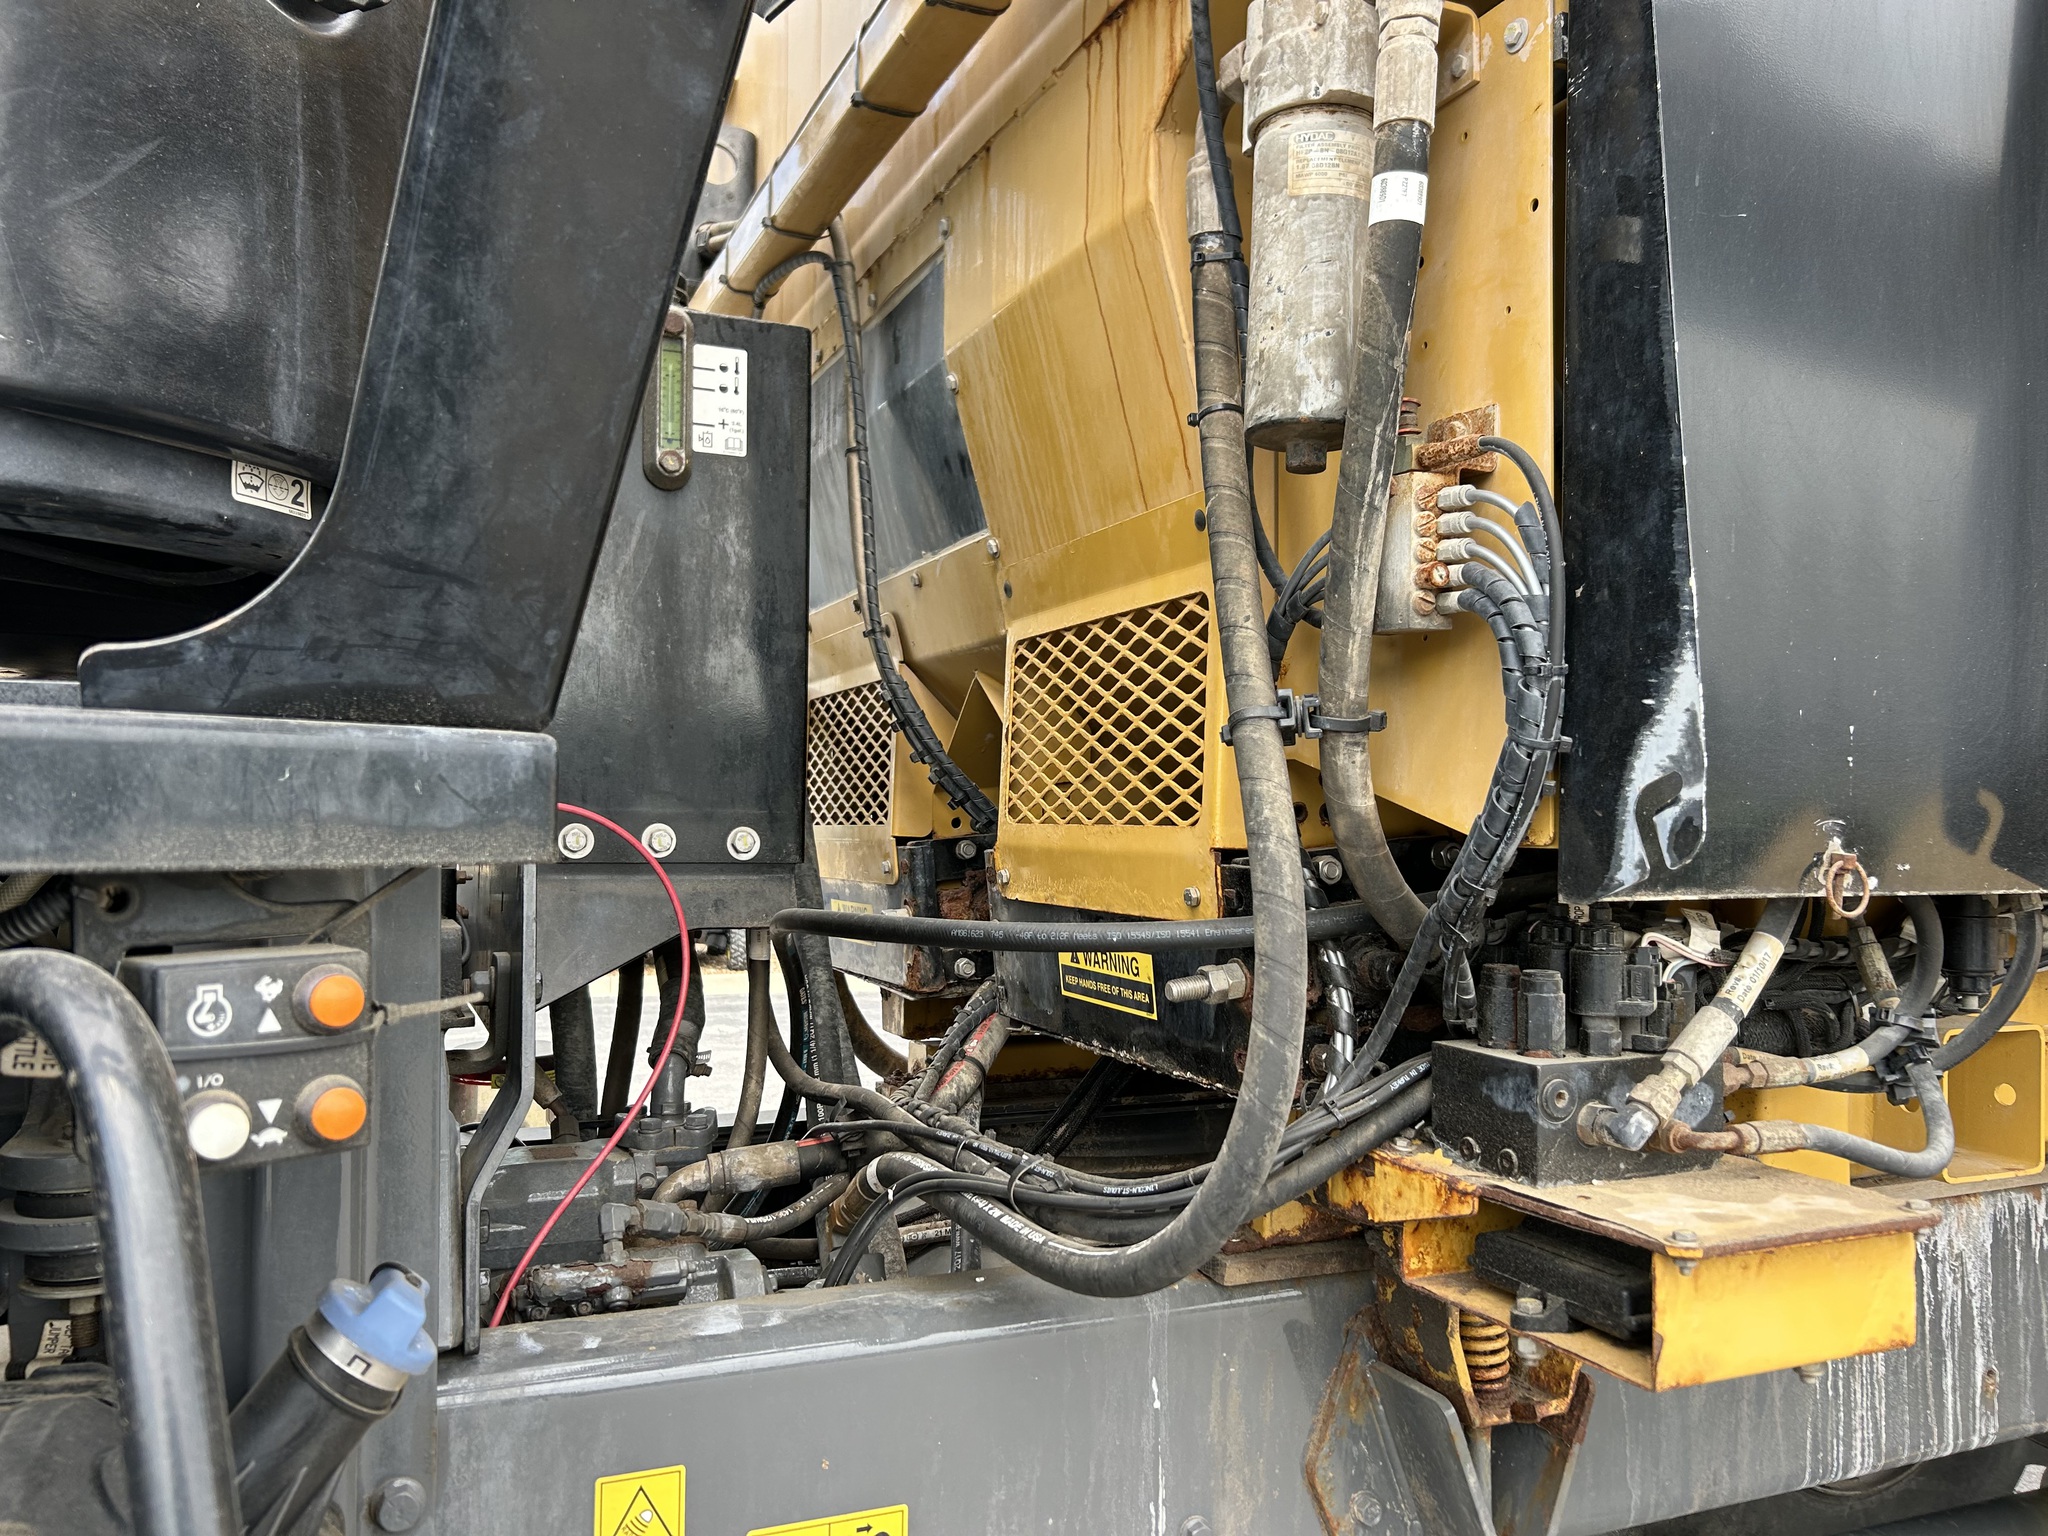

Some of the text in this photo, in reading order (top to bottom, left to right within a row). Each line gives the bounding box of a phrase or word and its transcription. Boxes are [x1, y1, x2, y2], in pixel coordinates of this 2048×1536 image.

[1295, 131, 1335, 143] HYDAC
[291, 479, 305, 508] 2
[1037, 932, 1047, 940] to
[1106, 932, 1122, 940] ISO
[1083, 952, 1140, 978] WARNING
[1748, 951, 1772, 985] 01/10/17
[1065, 974, 1150, 1004] KEEP HANDS FREE OF THIS AREA
[13, 1034, 38, 1070] TTLE
[1000, 1213, 1022, 1233] MADE
[1026, 1229, 1047, 1244] USA
[43, 1326, 62, 1354] JUMPER
